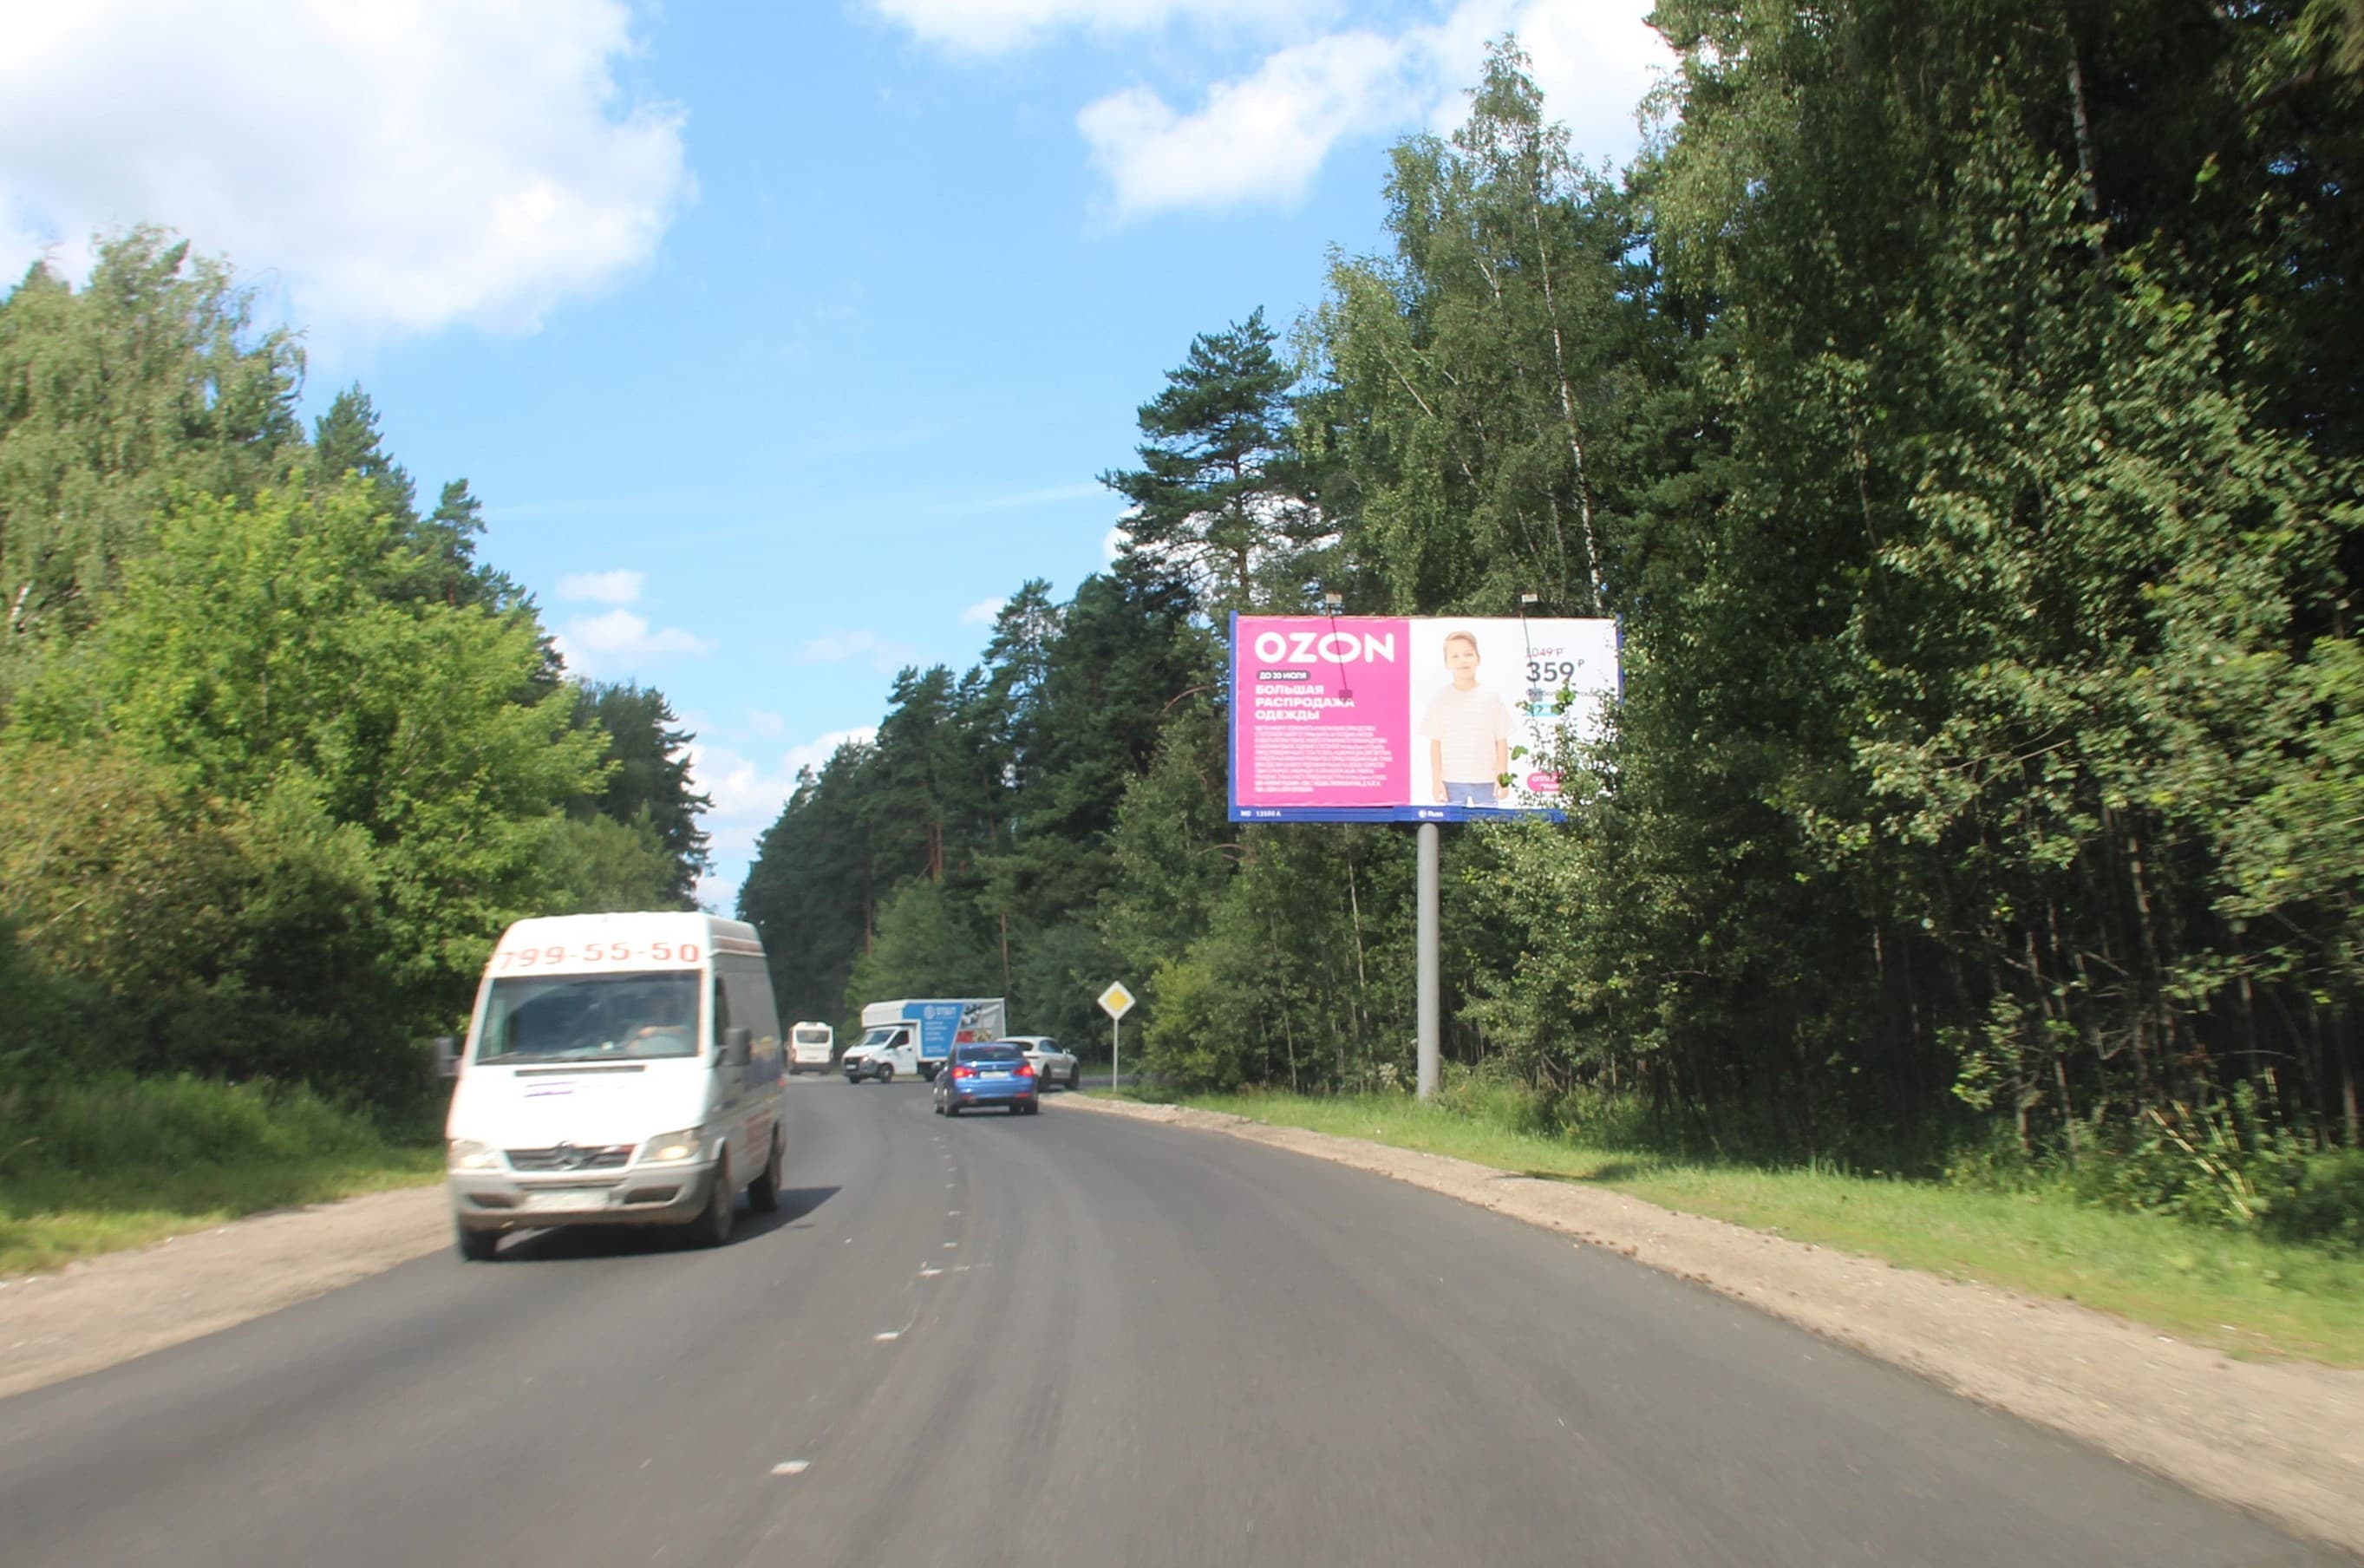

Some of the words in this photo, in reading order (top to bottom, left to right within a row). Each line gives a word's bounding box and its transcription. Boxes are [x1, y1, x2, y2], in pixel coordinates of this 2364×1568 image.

[1254, 631, 1394, 663] OZON
[1255, 685, 1325, 695] БОЛЬШАЯ
[1255, 697, 1355, 709] РАСПРОДАЖА
[1255, 709, 1320, 721] ОДЕЖДЫ
[500, 942, 701, 970] 799-55-50
